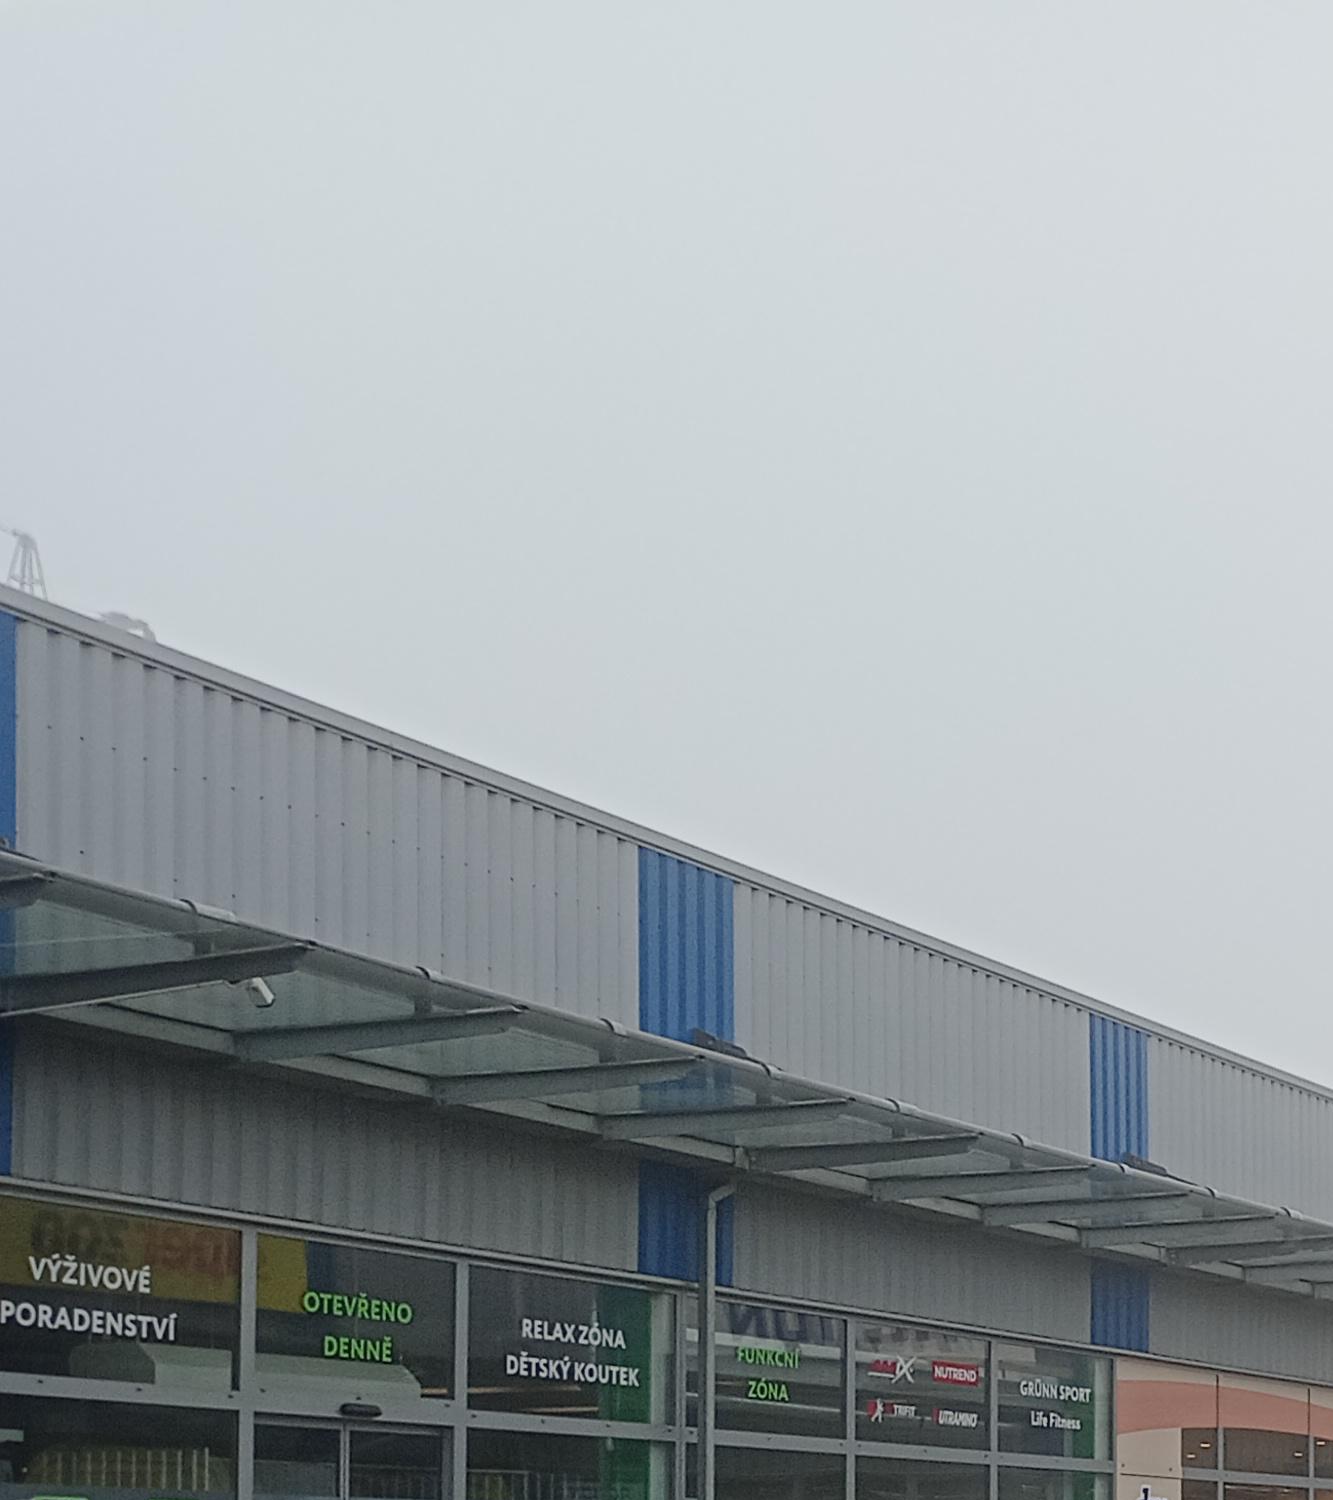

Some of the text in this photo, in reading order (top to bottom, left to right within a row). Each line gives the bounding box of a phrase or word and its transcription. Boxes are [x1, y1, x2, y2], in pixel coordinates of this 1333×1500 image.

[28, 1253, 151, 1294] VÝŽIVOVÉ
[0, 1300, 178, 1342] PORADENSTVÍ
[303, 1291, 413, 1325] OTEVŘENO
[324, 1335, 393, 1363] DENNĚ
[521, 1318, 627, 1350] RELAX ZÓNA
[505, 1351, 640, 1388] DĚTSKÝ KOUTEK
[934, 1365, 977, 1382] NUTREND
[748, 1377, 789, 1401] ZÓNA
[1059, 1385, 1091, 1402] SPORT
[1031, 1410, 1081, 1430] Life Fitness
